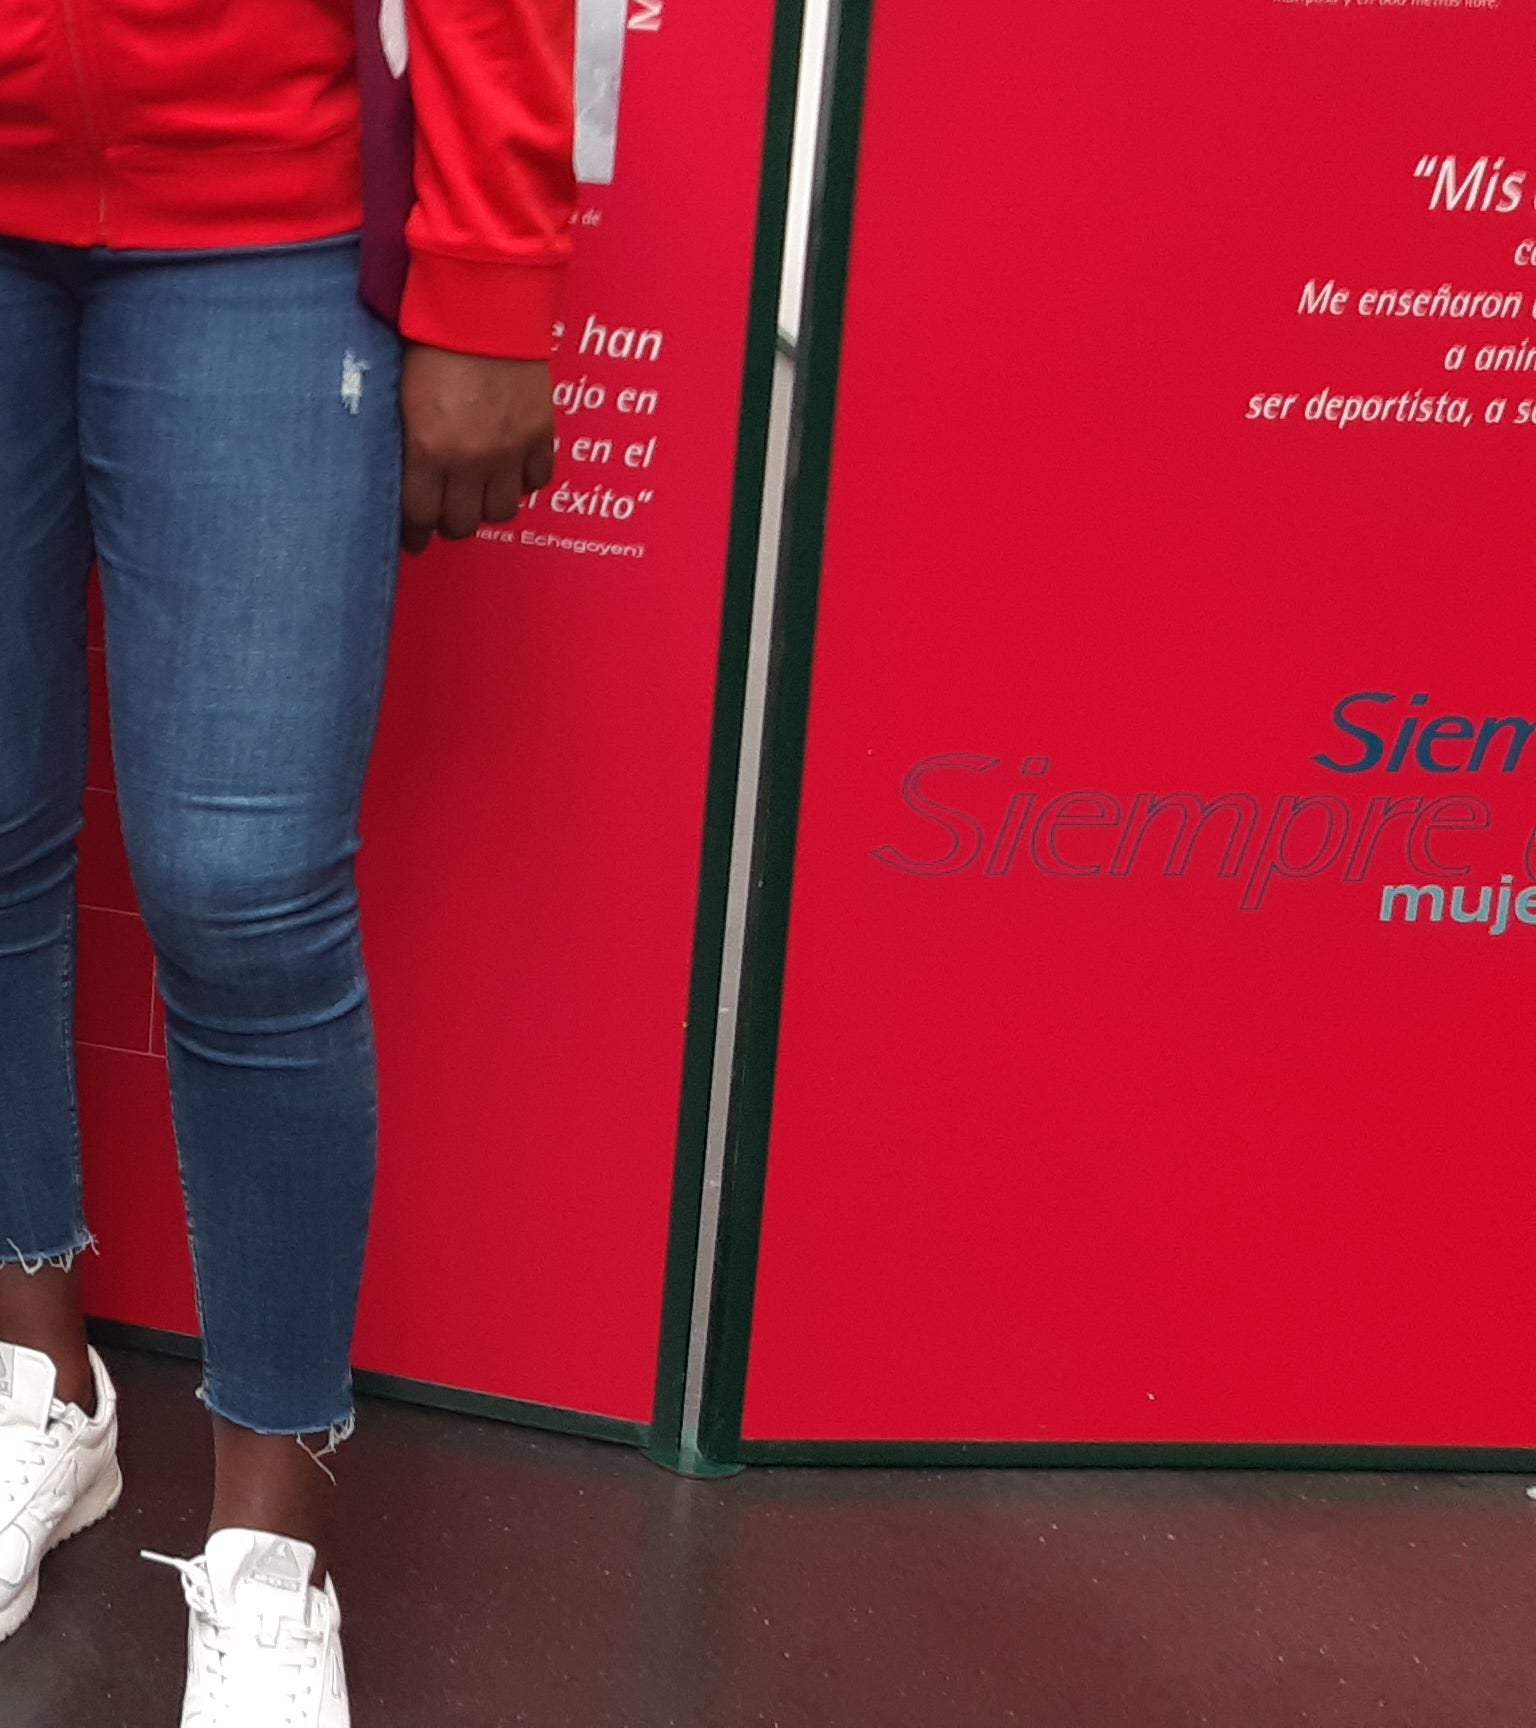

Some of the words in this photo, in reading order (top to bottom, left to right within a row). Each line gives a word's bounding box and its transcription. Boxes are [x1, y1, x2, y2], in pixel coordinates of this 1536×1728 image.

[1297, 278, 1349, 317] Me
[1357, 282, 1523, 320] enseñaron
[578, 312, 664, 363] han
[1442, 341, 1468, 371] a
[616, 386, 659, 416] en
[1244, 390, 1299, 422] ser
[1303, 387, 1474, 430] deportista,
[1484, 393, 1508, 425] a
[570, 437, 614, 464] en
[624, 434, 657, 469] el
[550, 479, 655, 521] éxito"
[868, 752, 1492, 912] Siempre
